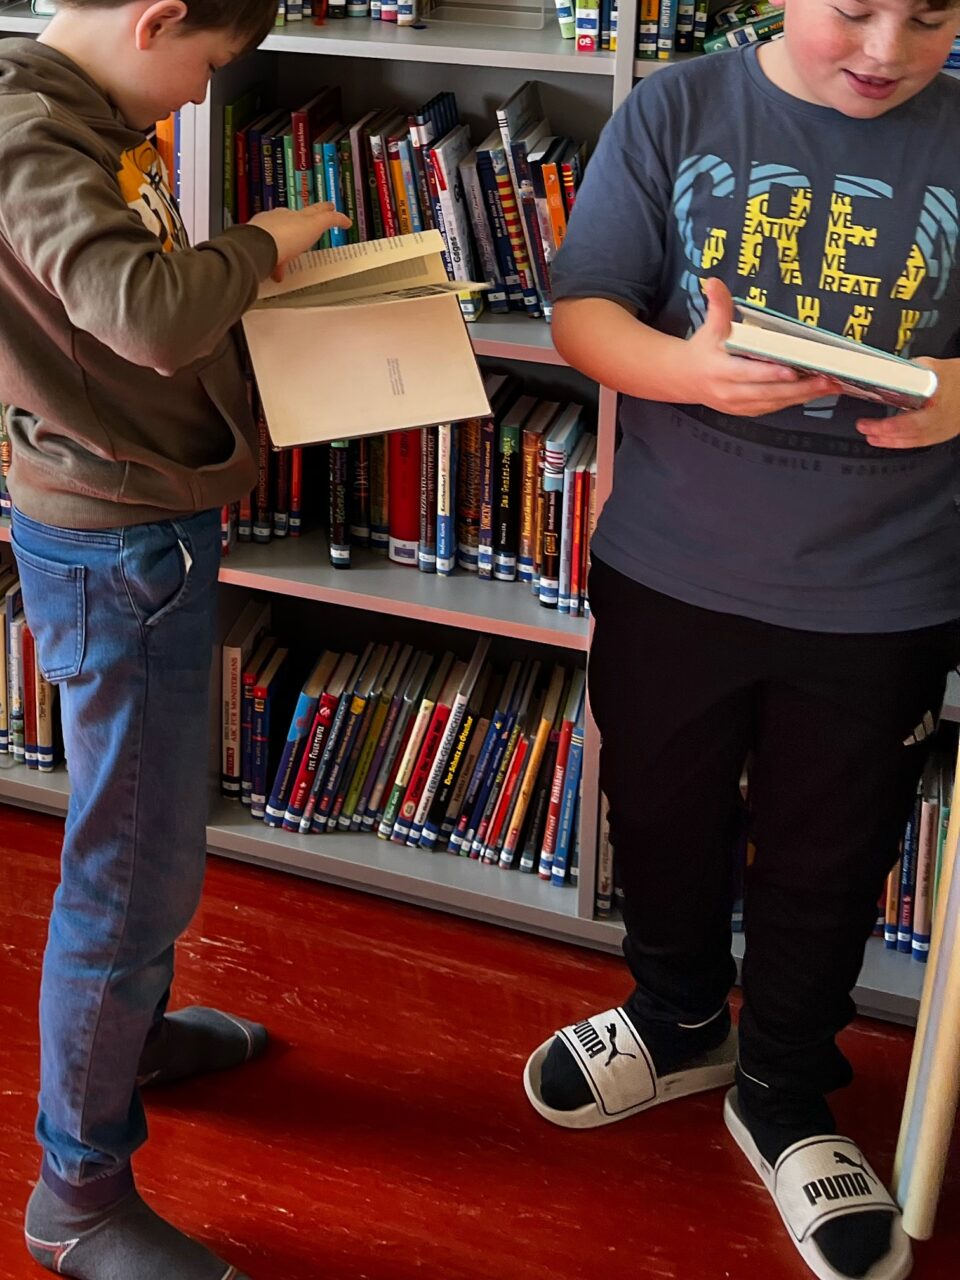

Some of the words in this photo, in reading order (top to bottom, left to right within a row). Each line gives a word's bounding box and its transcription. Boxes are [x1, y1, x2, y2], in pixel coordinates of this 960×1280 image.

[762, 452, 822, 472] WHILE
[501, 494, 509, 508] Das
[446, 751, 461, 772] Schatz
[444, 772, 453, 785] Der
[803, 1172, 871, 1206] PUMA
